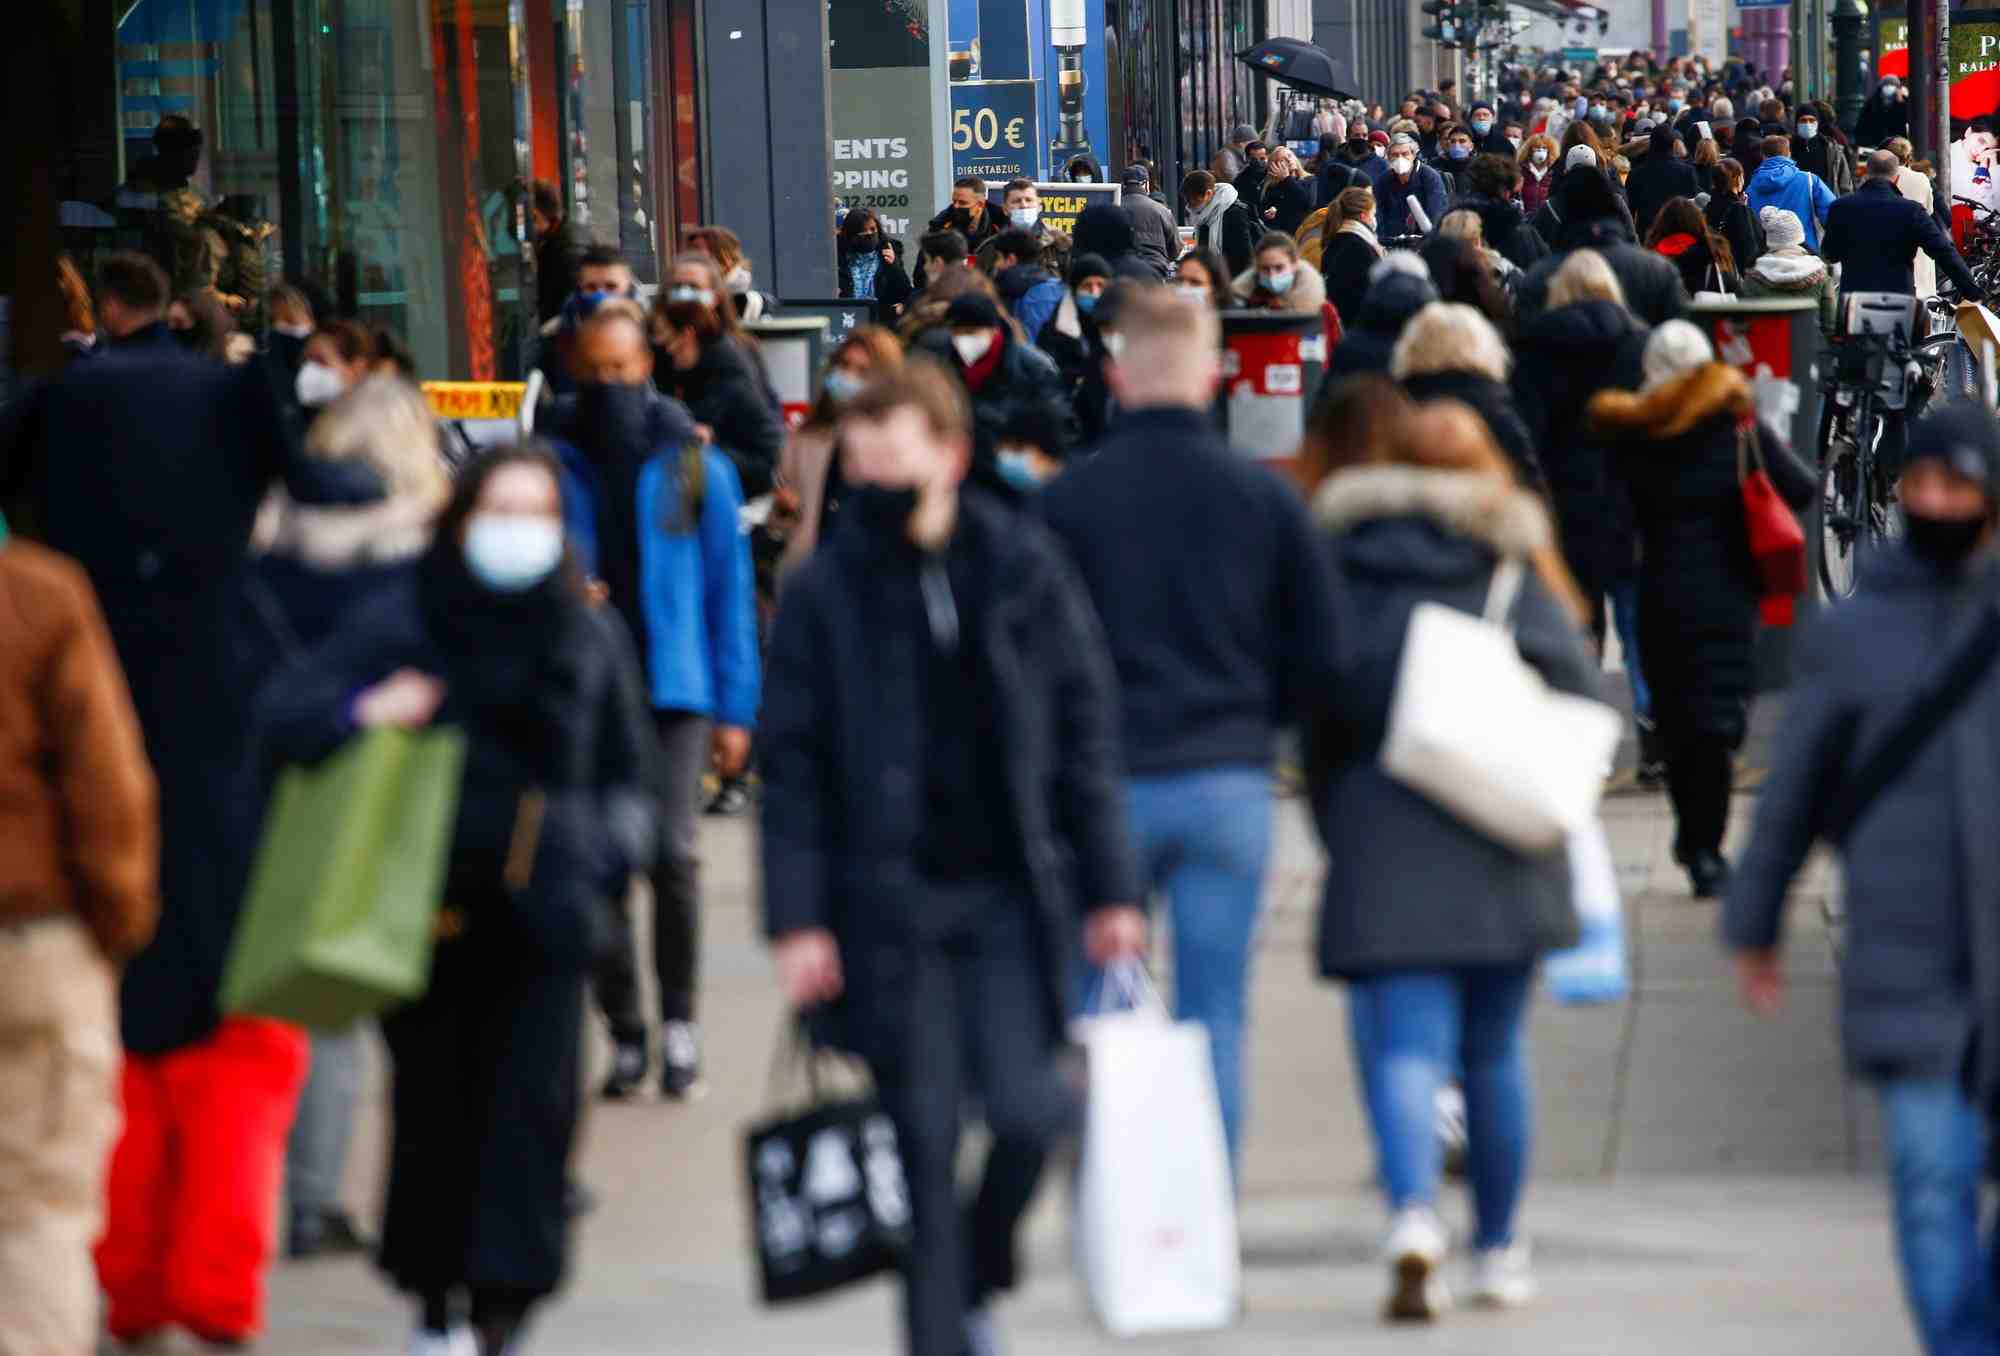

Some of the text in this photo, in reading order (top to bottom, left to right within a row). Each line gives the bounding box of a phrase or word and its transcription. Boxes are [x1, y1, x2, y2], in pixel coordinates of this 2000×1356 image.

[1979, 34, 2000, 57] P
[1959, 61, 2000, 73] RALP
[952, 107, 1025, 151] 50 €
[957, 164, 1021, 176] DIREKTABZUG
